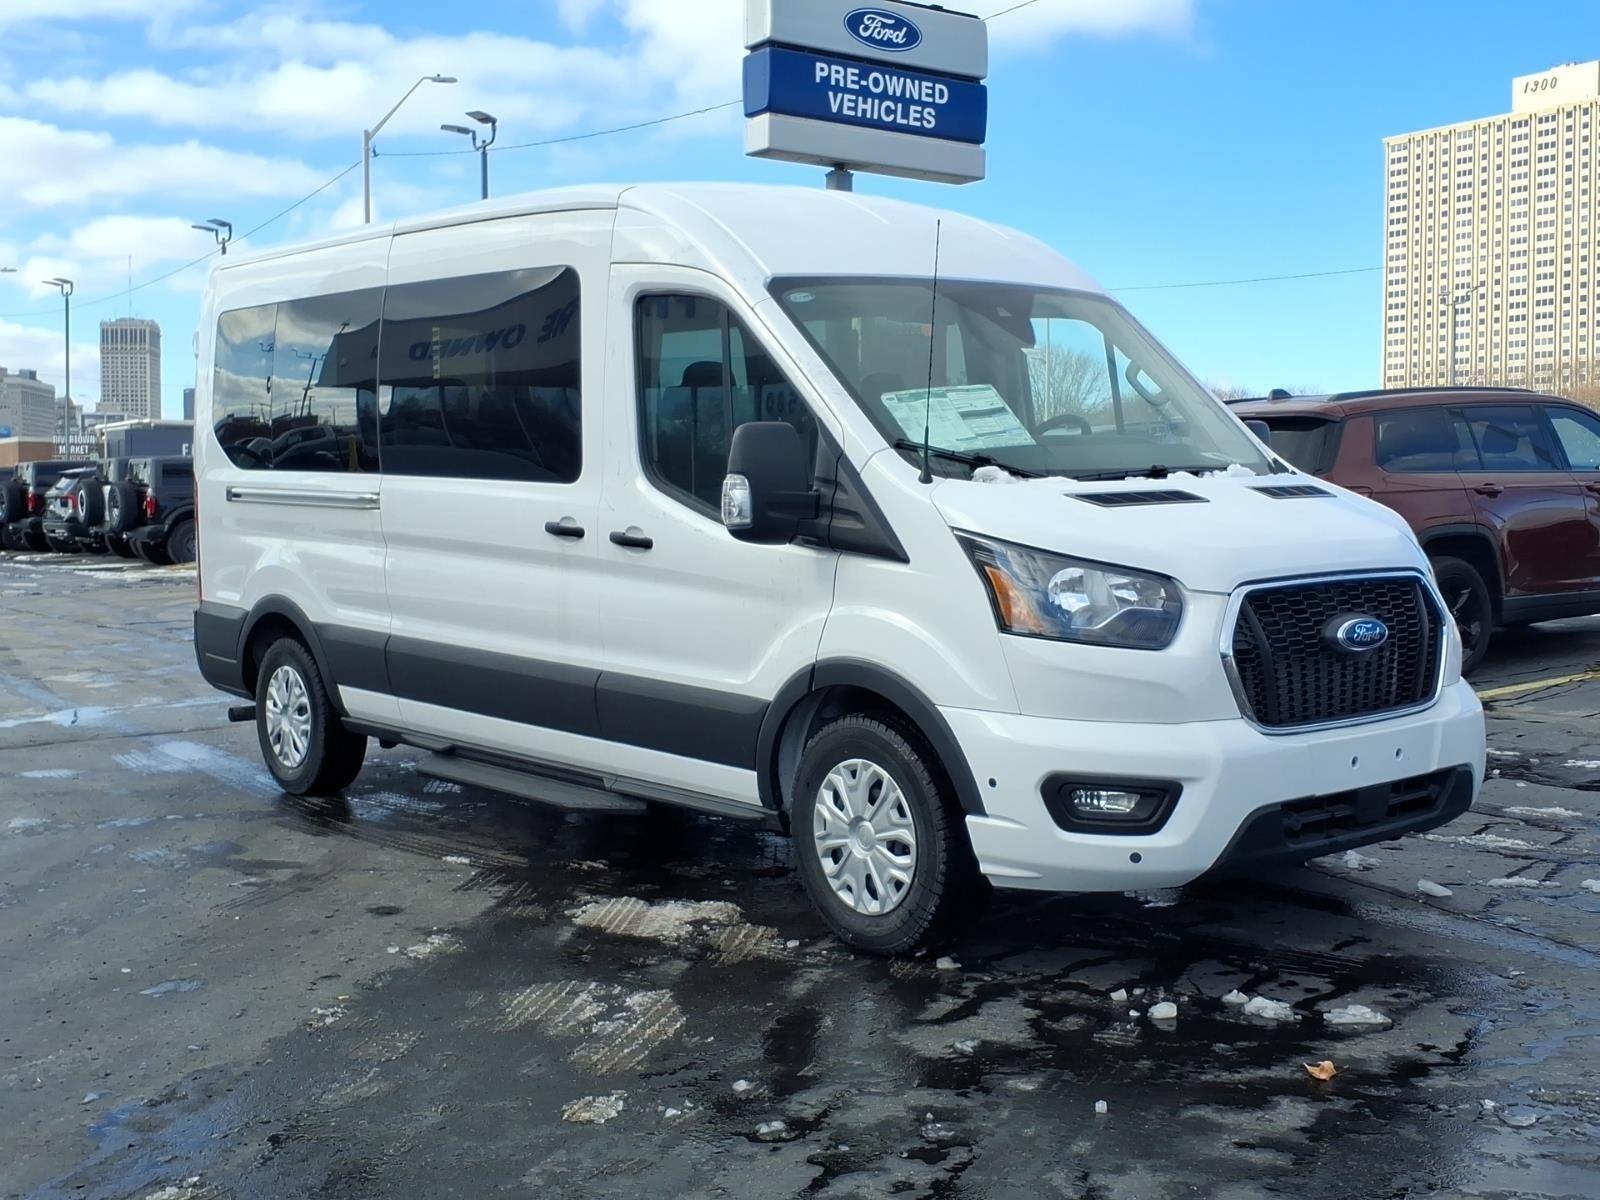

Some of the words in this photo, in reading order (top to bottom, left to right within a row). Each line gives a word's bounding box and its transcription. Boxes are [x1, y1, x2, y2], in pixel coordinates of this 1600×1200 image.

[859, 13, 907, 44] Ford
[815, 62, 949, 105] PRE-OWNED
[1523, 76, 1558, 94] 1300
[828, 91, 936, 129] VEHICLES
[52, 435, 96, 444] RIVRTOWN
[58, 445, 89, 455] MRKET
